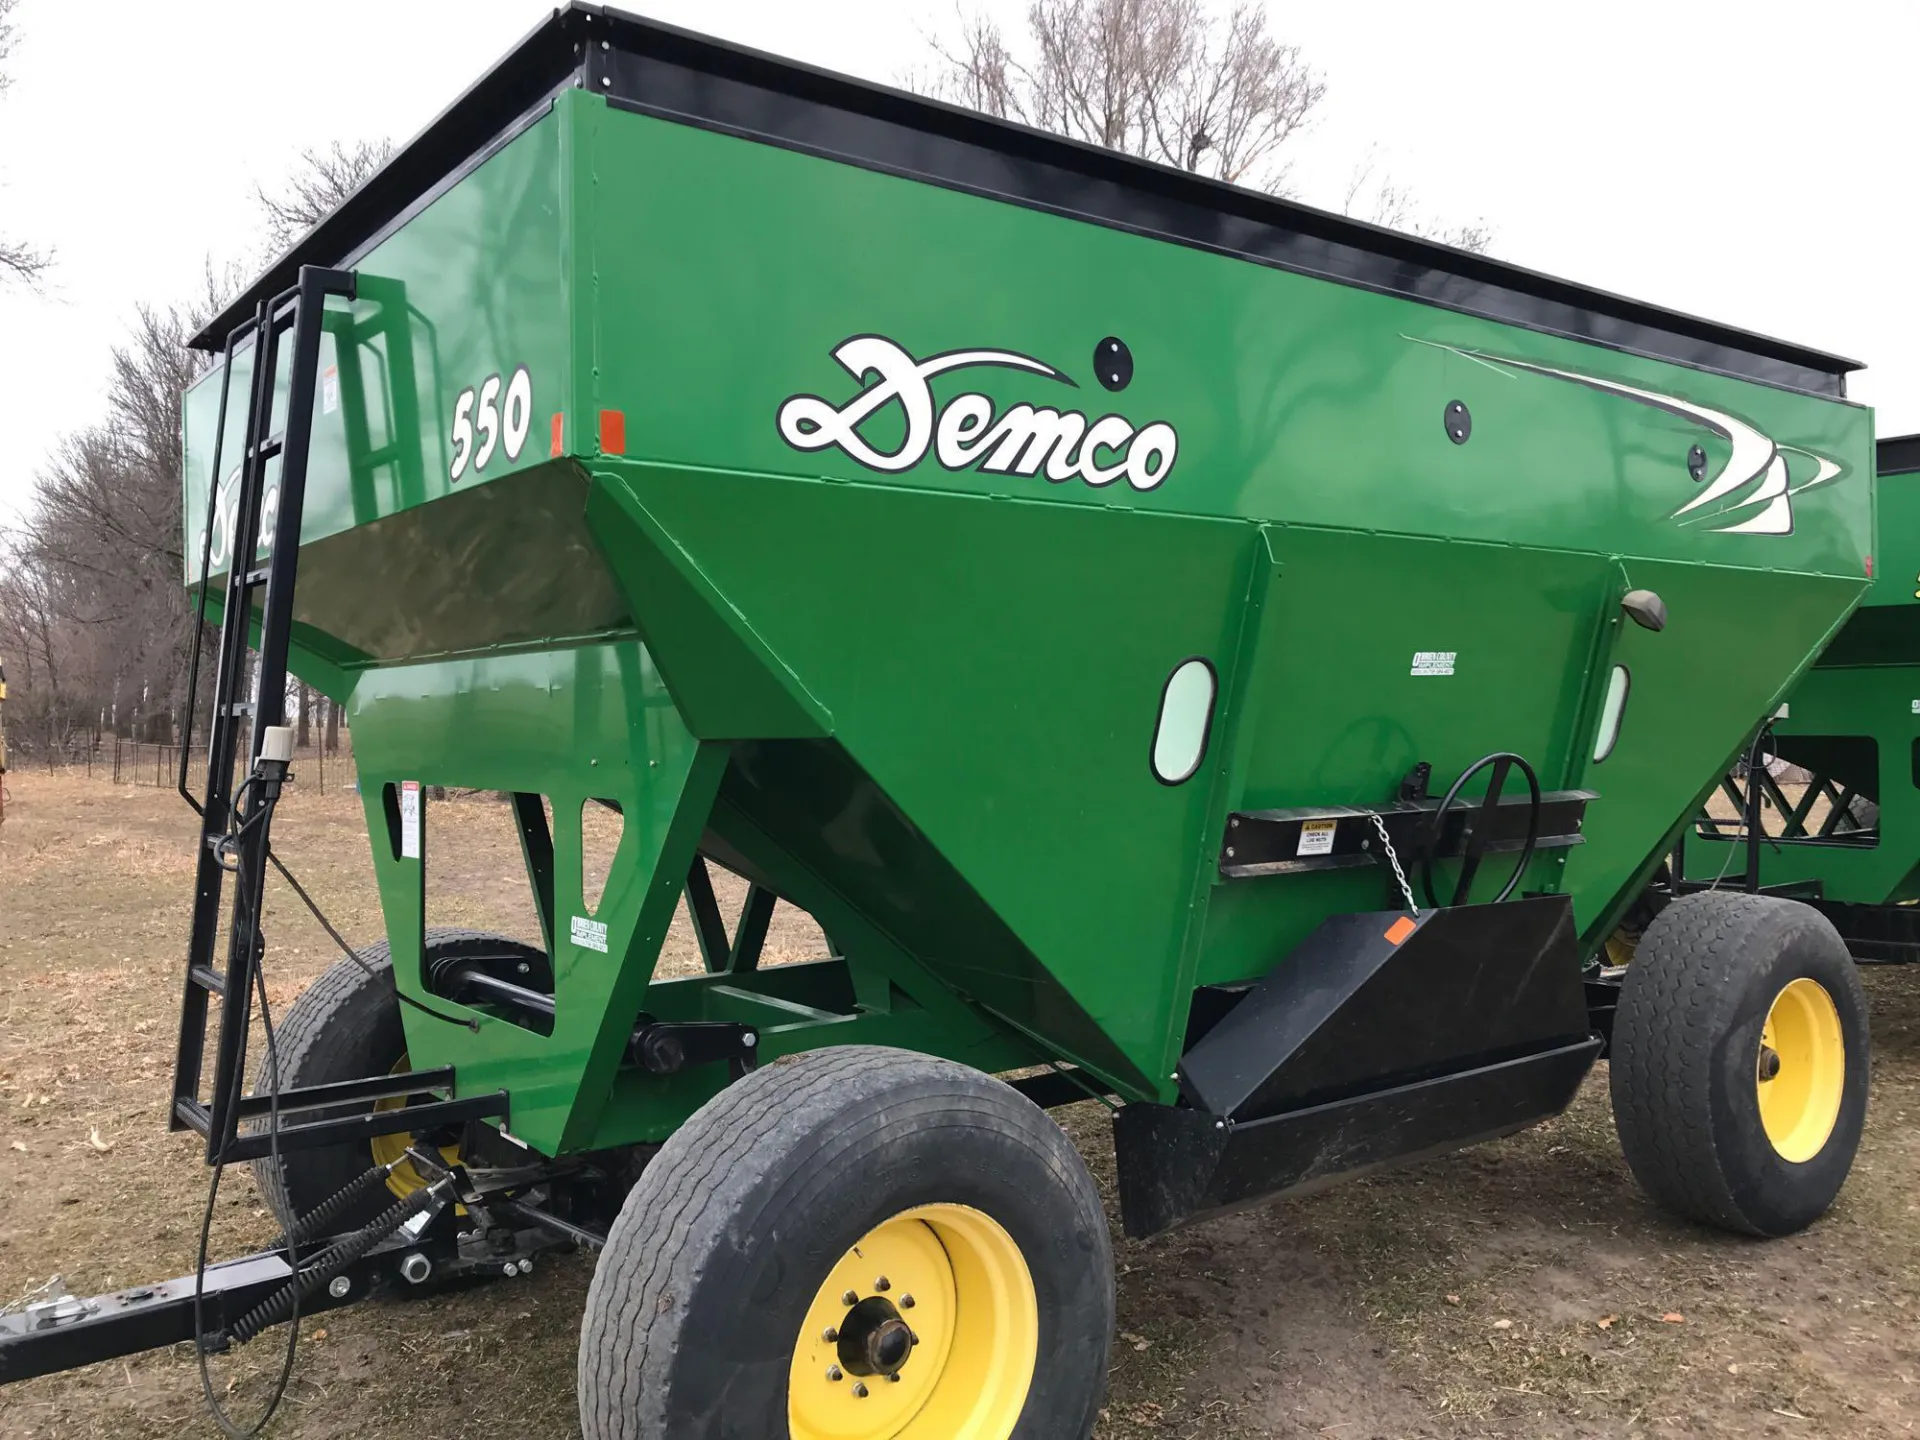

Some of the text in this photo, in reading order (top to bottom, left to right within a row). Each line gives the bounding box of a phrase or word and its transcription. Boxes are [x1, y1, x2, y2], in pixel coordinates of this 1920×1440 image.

[450, 361, 532, 484] 550
[776, 333, 1180, 492] Demco
[1310, 822, 1333, 830] CAUTION
